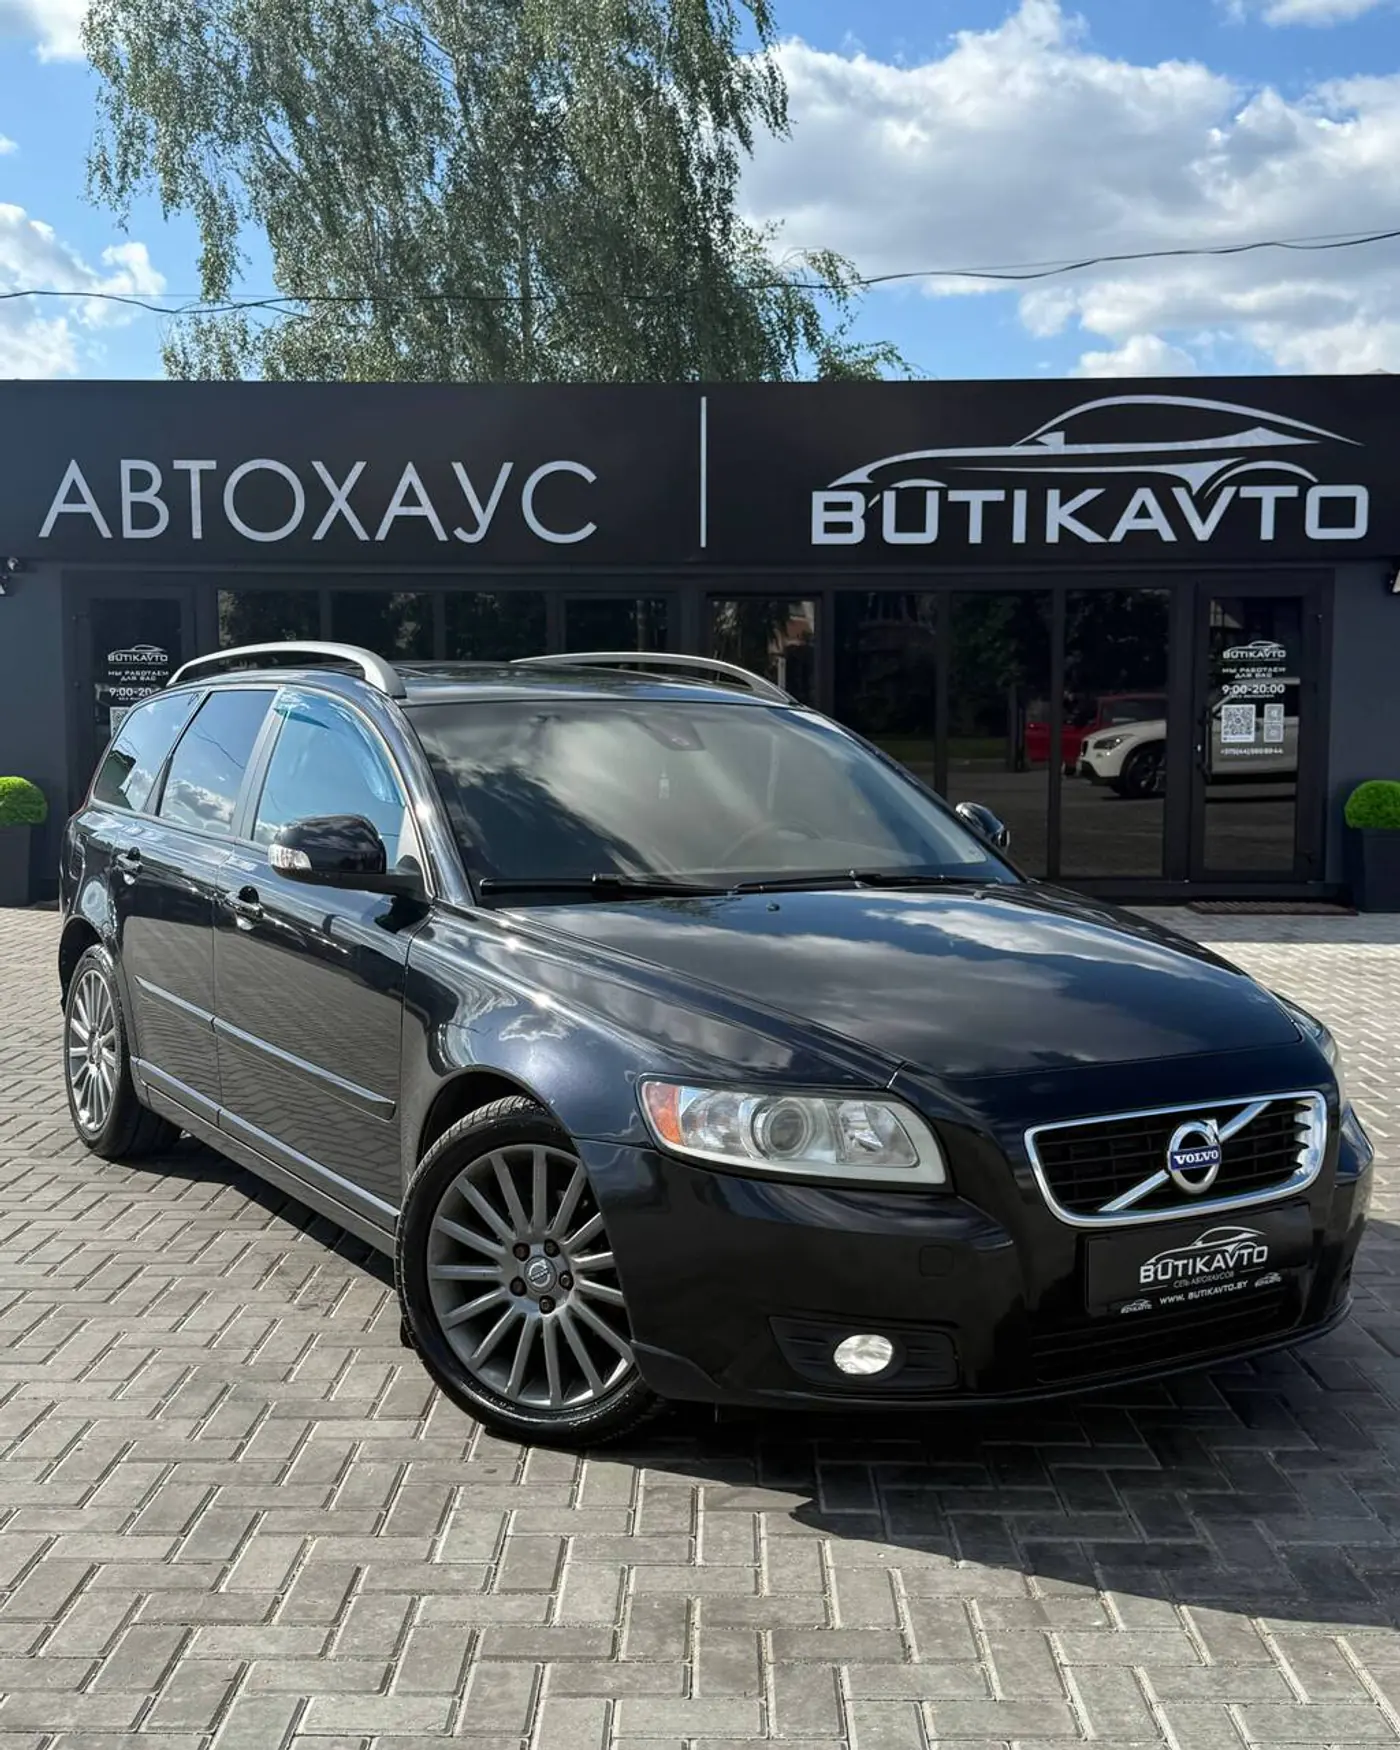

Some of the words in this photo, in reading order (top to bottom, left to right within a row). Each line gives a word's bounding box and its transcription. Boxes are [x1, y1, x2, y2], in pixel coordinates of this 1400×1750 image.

[38, 458, 598, 544] АВТОХАУС
[810, 484, 1369, 545] BUTIKAVTO
[107, 654, 168, 662] BUTIKAVTO
[1222, 650, 1286, 659] BUTIKAVTO
[1222, 684, 1286, 694] 9:00-20:00
[1173, 1149, 1219, 1165] VOLVO
[1139, 1246, 1268, 1284] BUTIKAVTO
